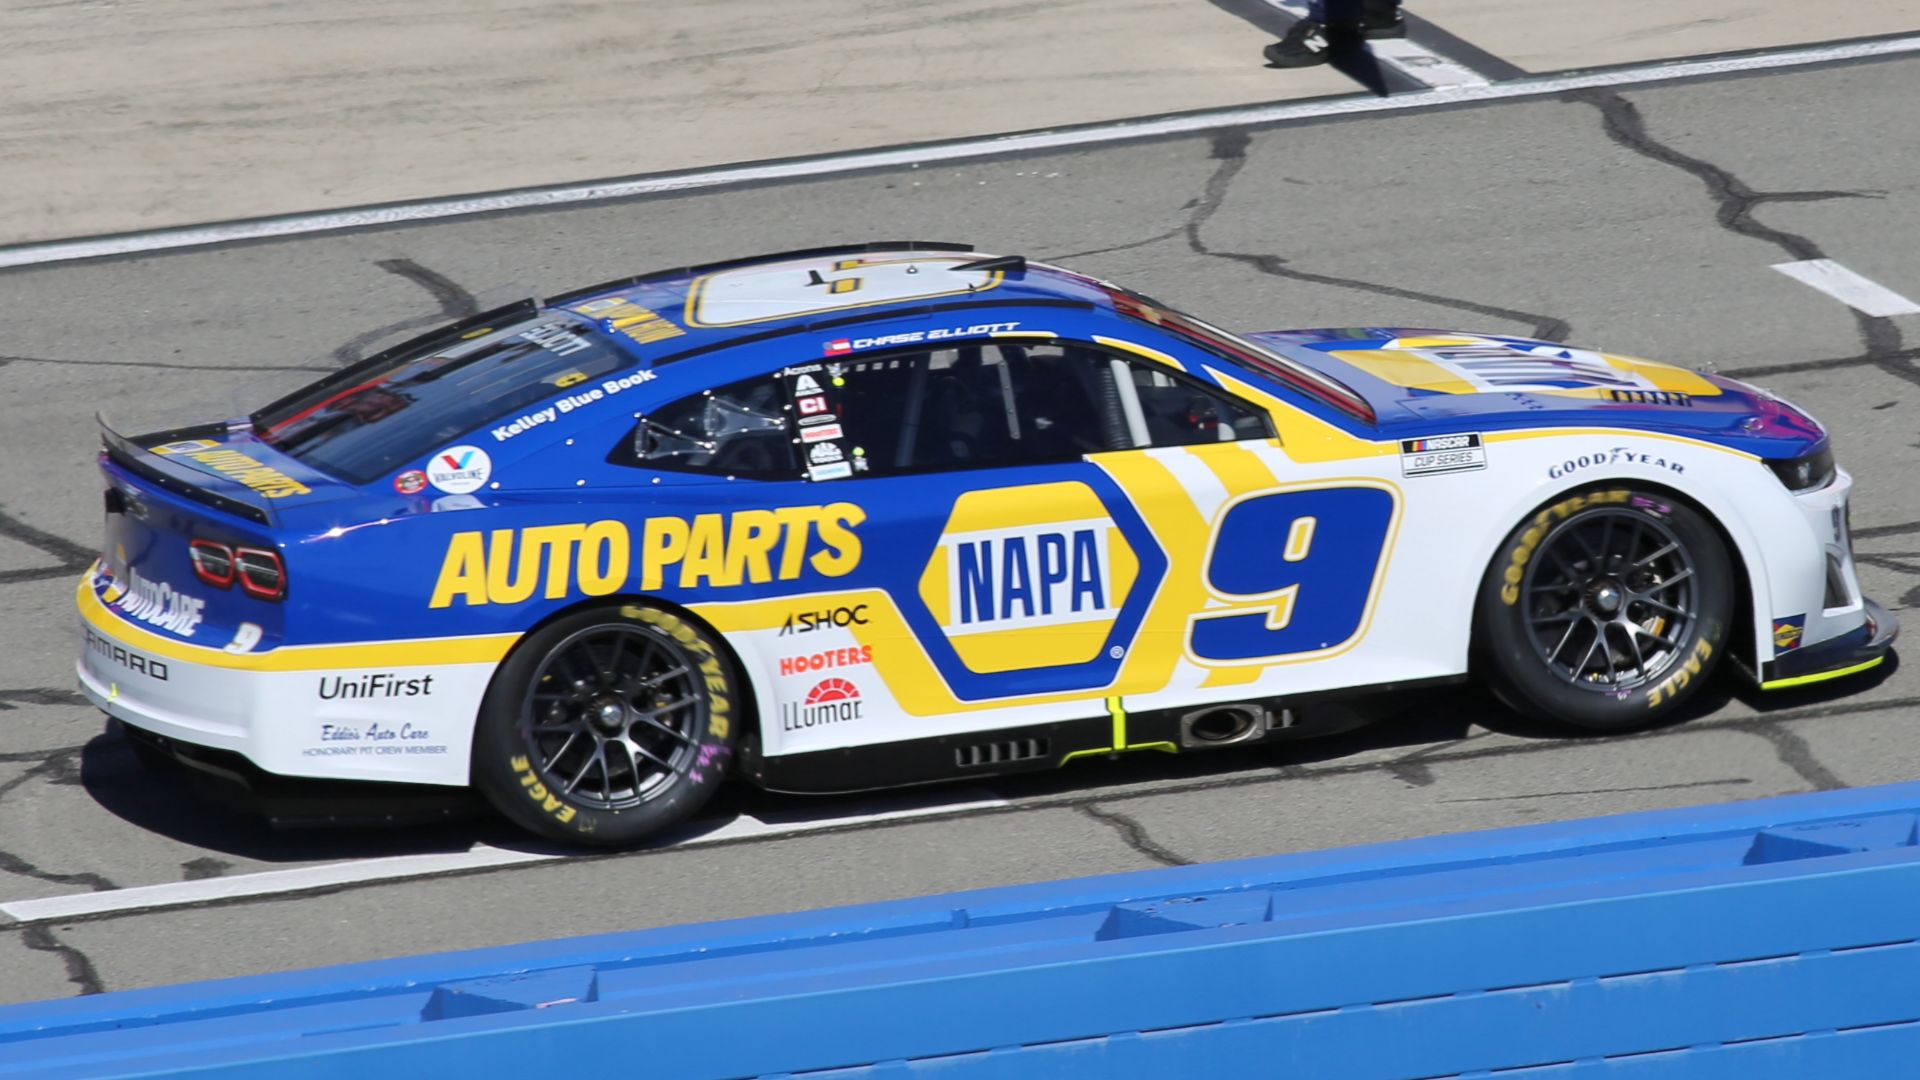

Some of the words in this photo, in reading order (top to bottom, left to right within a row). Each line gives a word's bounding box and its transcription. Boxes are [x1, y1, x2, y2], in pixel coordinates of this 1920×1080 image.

[852, 331, 924, 349] CHASE
[927, 321, 1021, 340] ELLIOTT
[491, 408, 557, 442] Kelley
[555, 387, 603, 415] Blue
[601, 367, 658, 396] Book
[1427, 436, 1470, 450] NASCAR
[1414, 455, 1435, 467] CUP
[1436, 451, 1473, 464] SERIES
[433, 467, 485, 483] VALVOLINE
[428, 520, 630, 609] AUTO
[640, 502, 867, 591] PARTS
[958, 528, 1106, 625] NAPA
[1188, 480, 1402, 665] 9
[224, 621, 263, 655] 9
[779, 645, 872, 676] HOOTERS
[1646, 637, 1713, 709] EAGLE
[318, 673, 433, 700] UniFirst
[365, 722, 397, 741] Auto
[400, 722, 430, 740] Care
[302, 746, 358, 756] HONORARY
[359, 746, 373, 755] PIT
[375, 745, 403, 755] CREW
[404, 745, 448, 754] MEMBER
[511, 754, 577, 823] EAGLE
